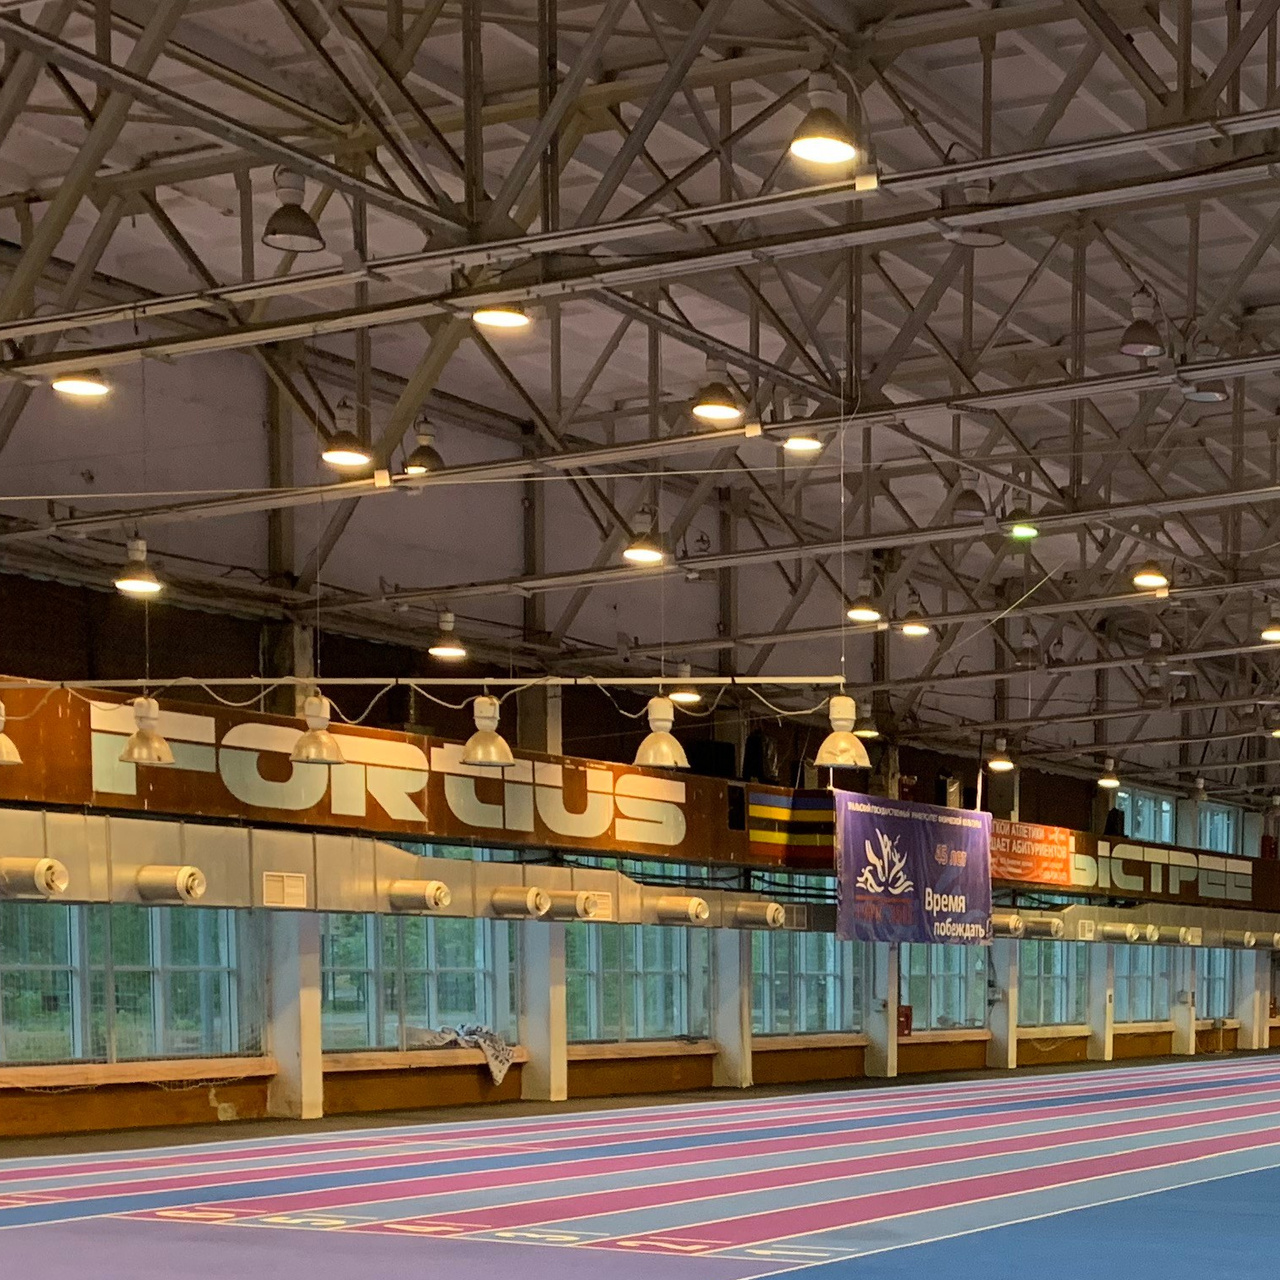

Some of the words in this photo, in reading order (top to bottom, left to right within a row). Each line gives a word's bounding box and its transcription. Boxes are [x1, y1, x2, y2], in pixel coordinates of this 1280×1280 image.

[91, 700, 686, 846] FORTIUS
[1012, 840, 1067, 859] АБИТУРИЕНТОВ
[1069, 835, 1253, 901] ЫСТРЕЕ
[925, 887, 966, 917] Время
[155, 1209, 236, 1219] 6
[262, 1216, 347, 1226] 5
[383, 1223, 465, 1233] 4
[494, 1231, 581, 1242] 3
[616, 1240, 710, 1252] 2
[745, 1248, 831, 1257] 1
